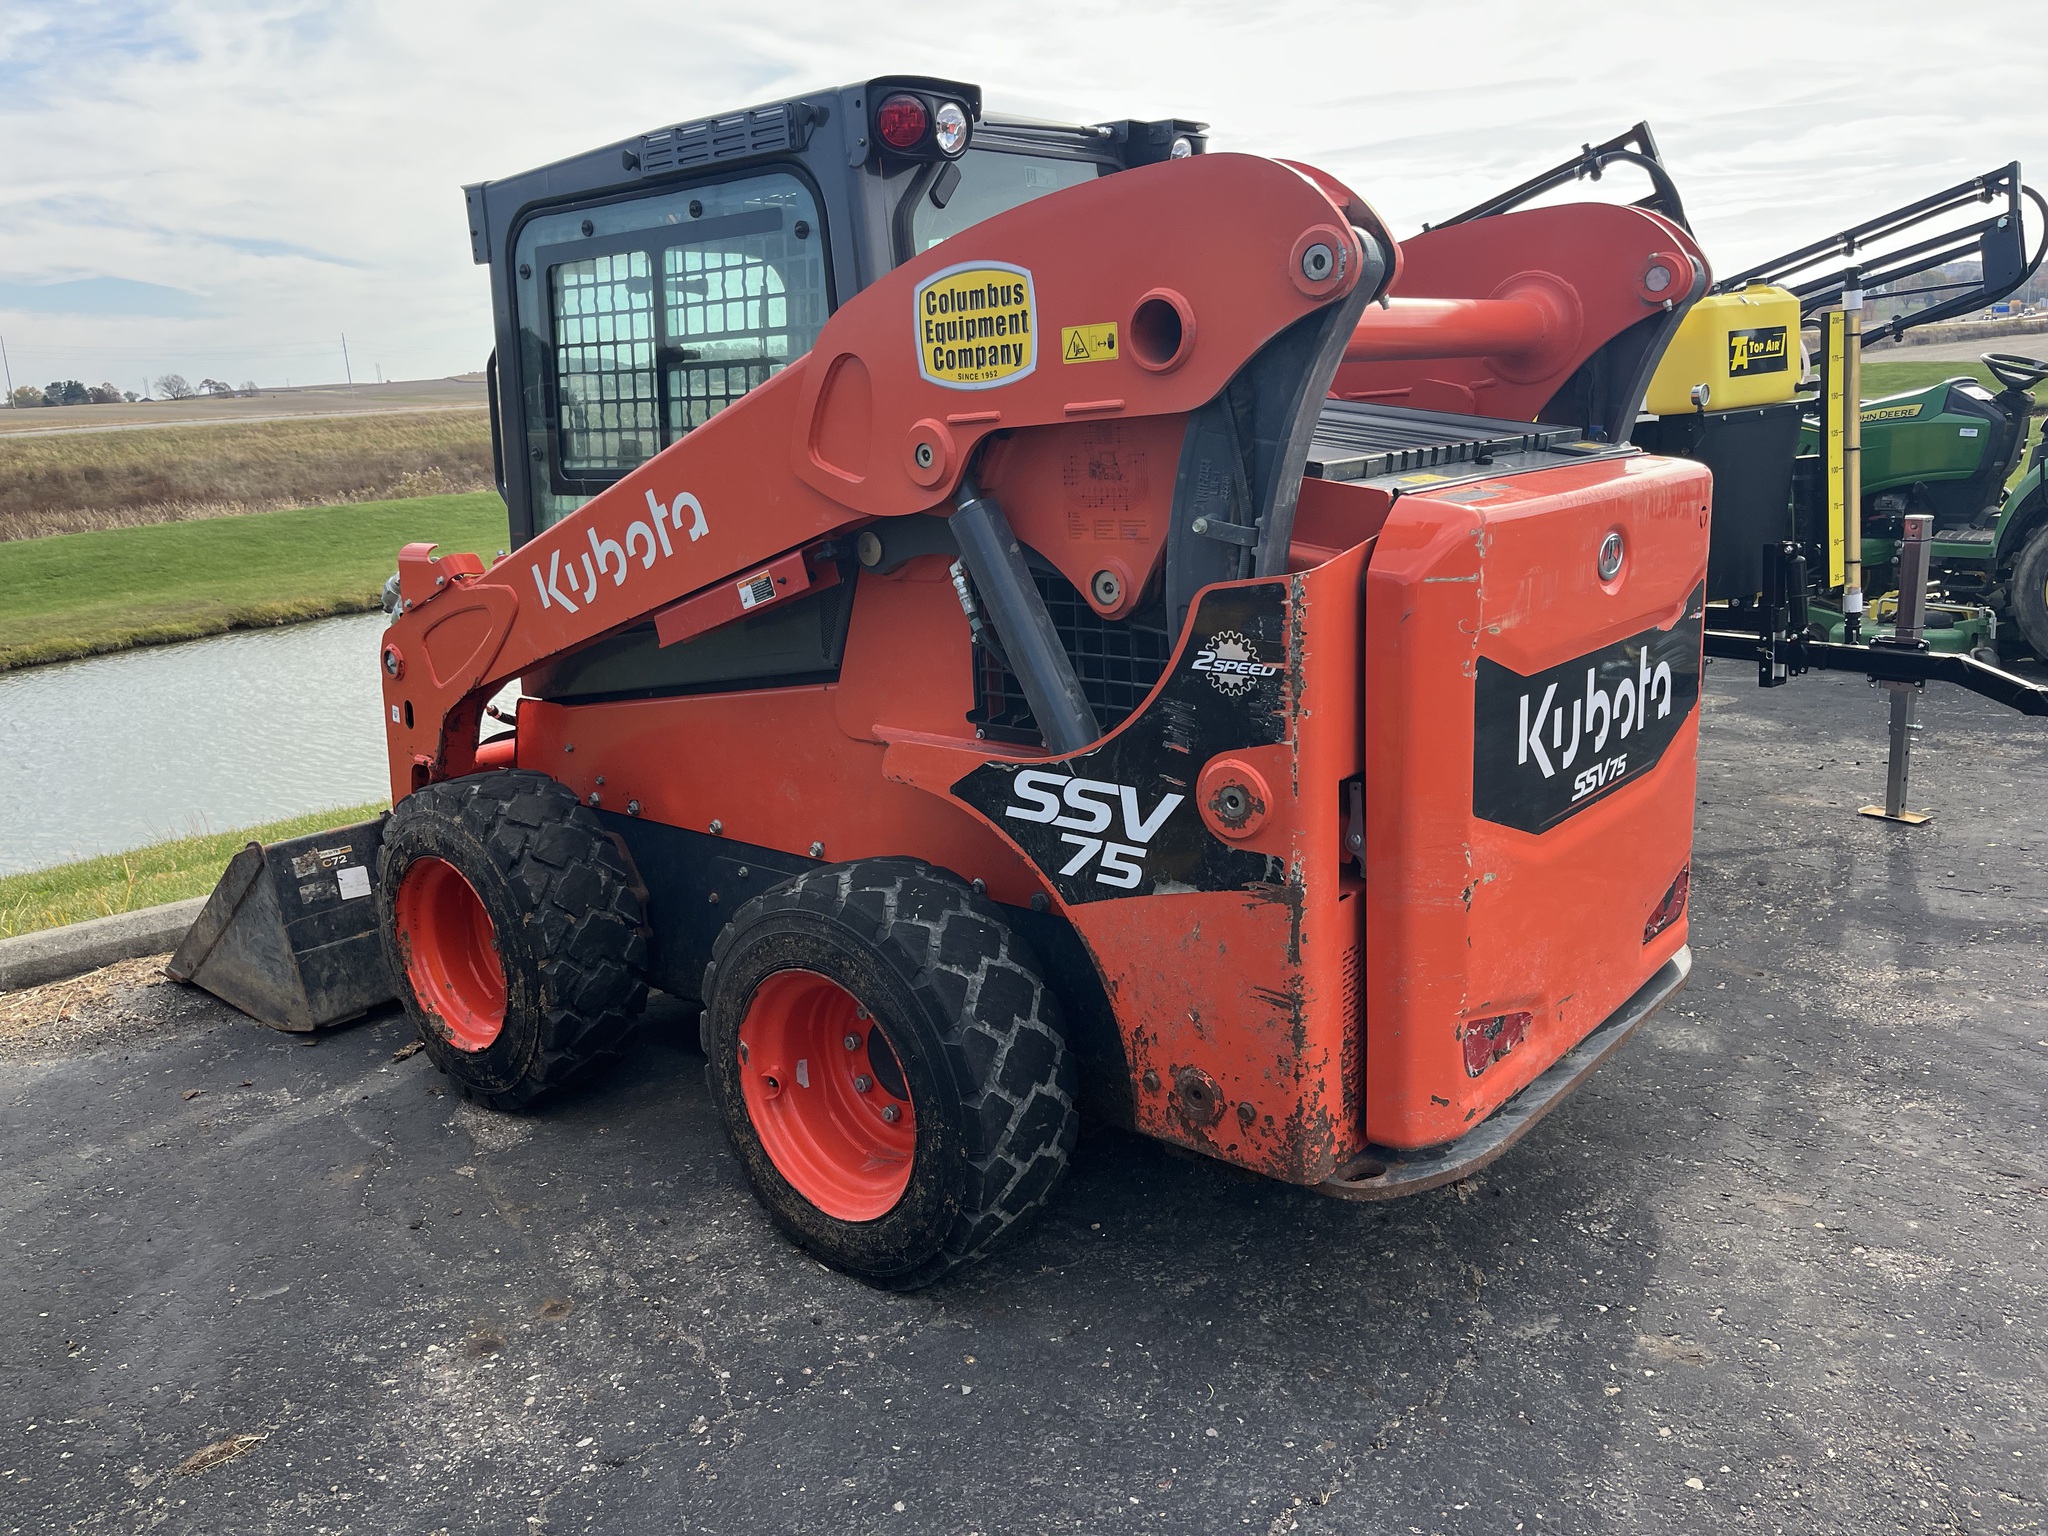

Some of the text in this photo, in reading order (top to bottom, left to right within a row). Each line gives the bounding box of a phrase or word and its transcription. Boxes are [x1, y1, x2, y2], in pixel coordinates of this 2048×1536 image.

[926, 283, 1025, 316] Columbus
[925, 310, 1029, 345] Equipment
[1832, 316, 1840, 325] 200
[1749, 339, 1780, 354] TOP AIR
[933, 343, 1023, 371] Company
[1831, 354, 1839, 362] 175
[957, 370, 998, 381] SINCE 1952
[1831, 392, 1839, 400] 150
[1879, 408, 1916, 419] DEERE
[1831, 466, 1839, 474] 100
[531, 488, 710, 614] Kubota
[1518, 645, 1672, 779] Kubota
[1005, 769, 1185, 843] SSV
[322, 854, 348, 868] C72
[1058, 832, 1148, 889] 75
